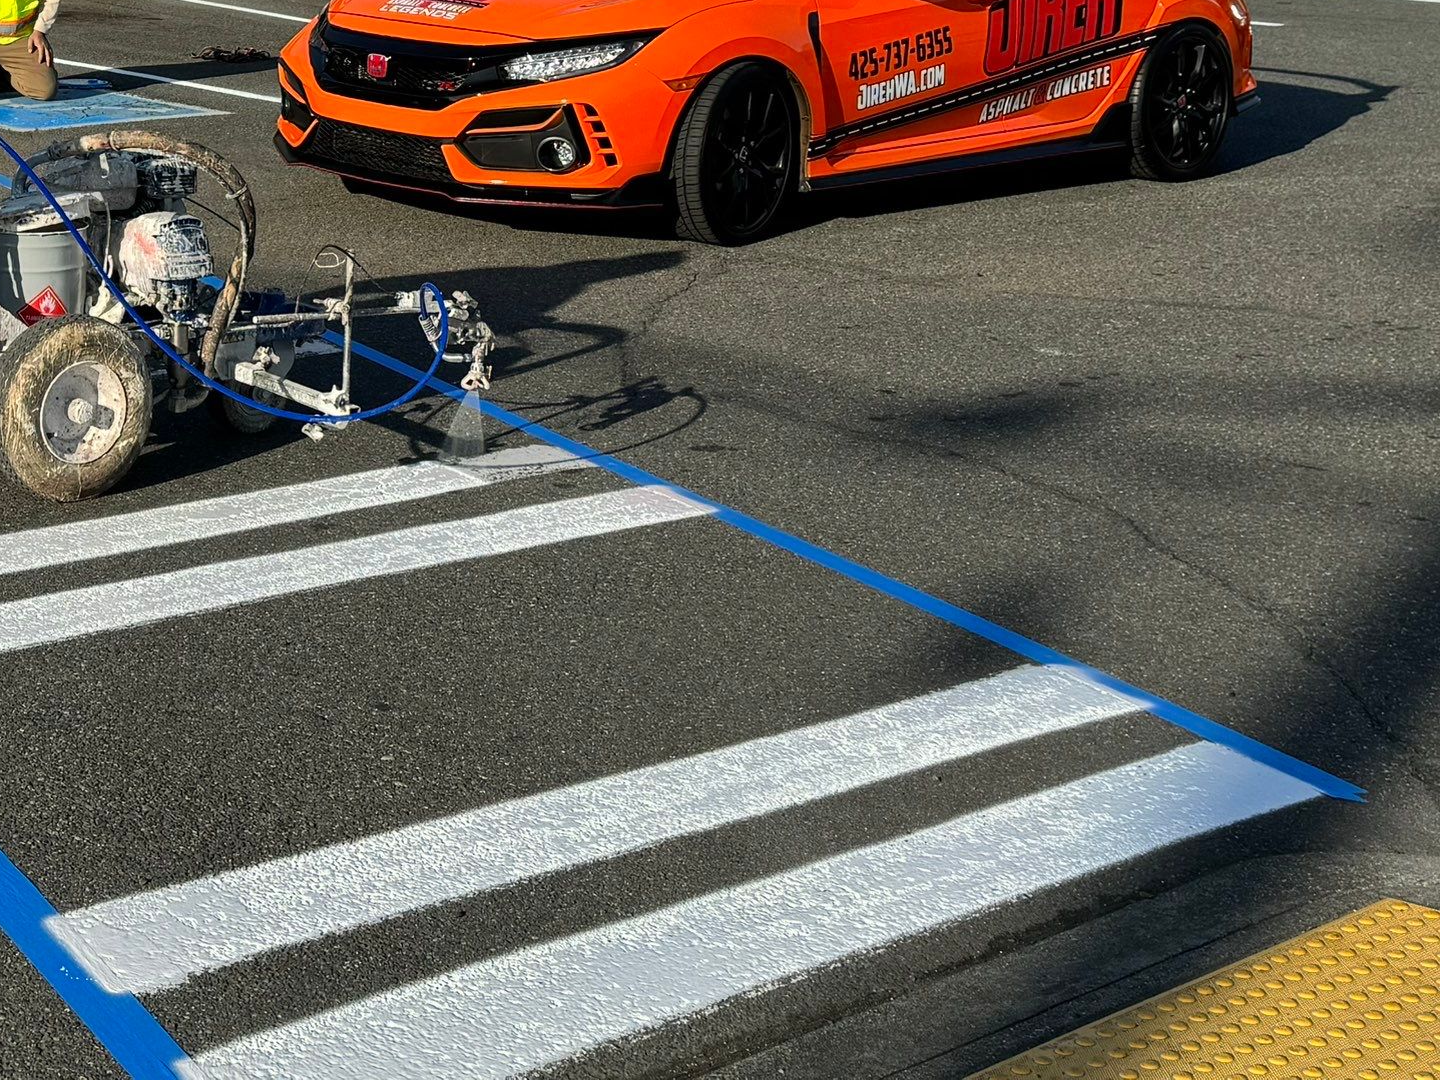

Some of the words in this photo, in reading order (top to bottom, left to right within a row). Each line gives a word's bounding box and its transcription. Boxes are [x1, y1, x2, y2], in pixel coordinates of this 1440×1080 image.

[378, 4, 458, 20] LEGENDS
[849, 25, 953, 80] 425-737-6355
[977, 87, 1035, 124] ASPHALT
[1046, 65, 1111, 101] CONCRETE
